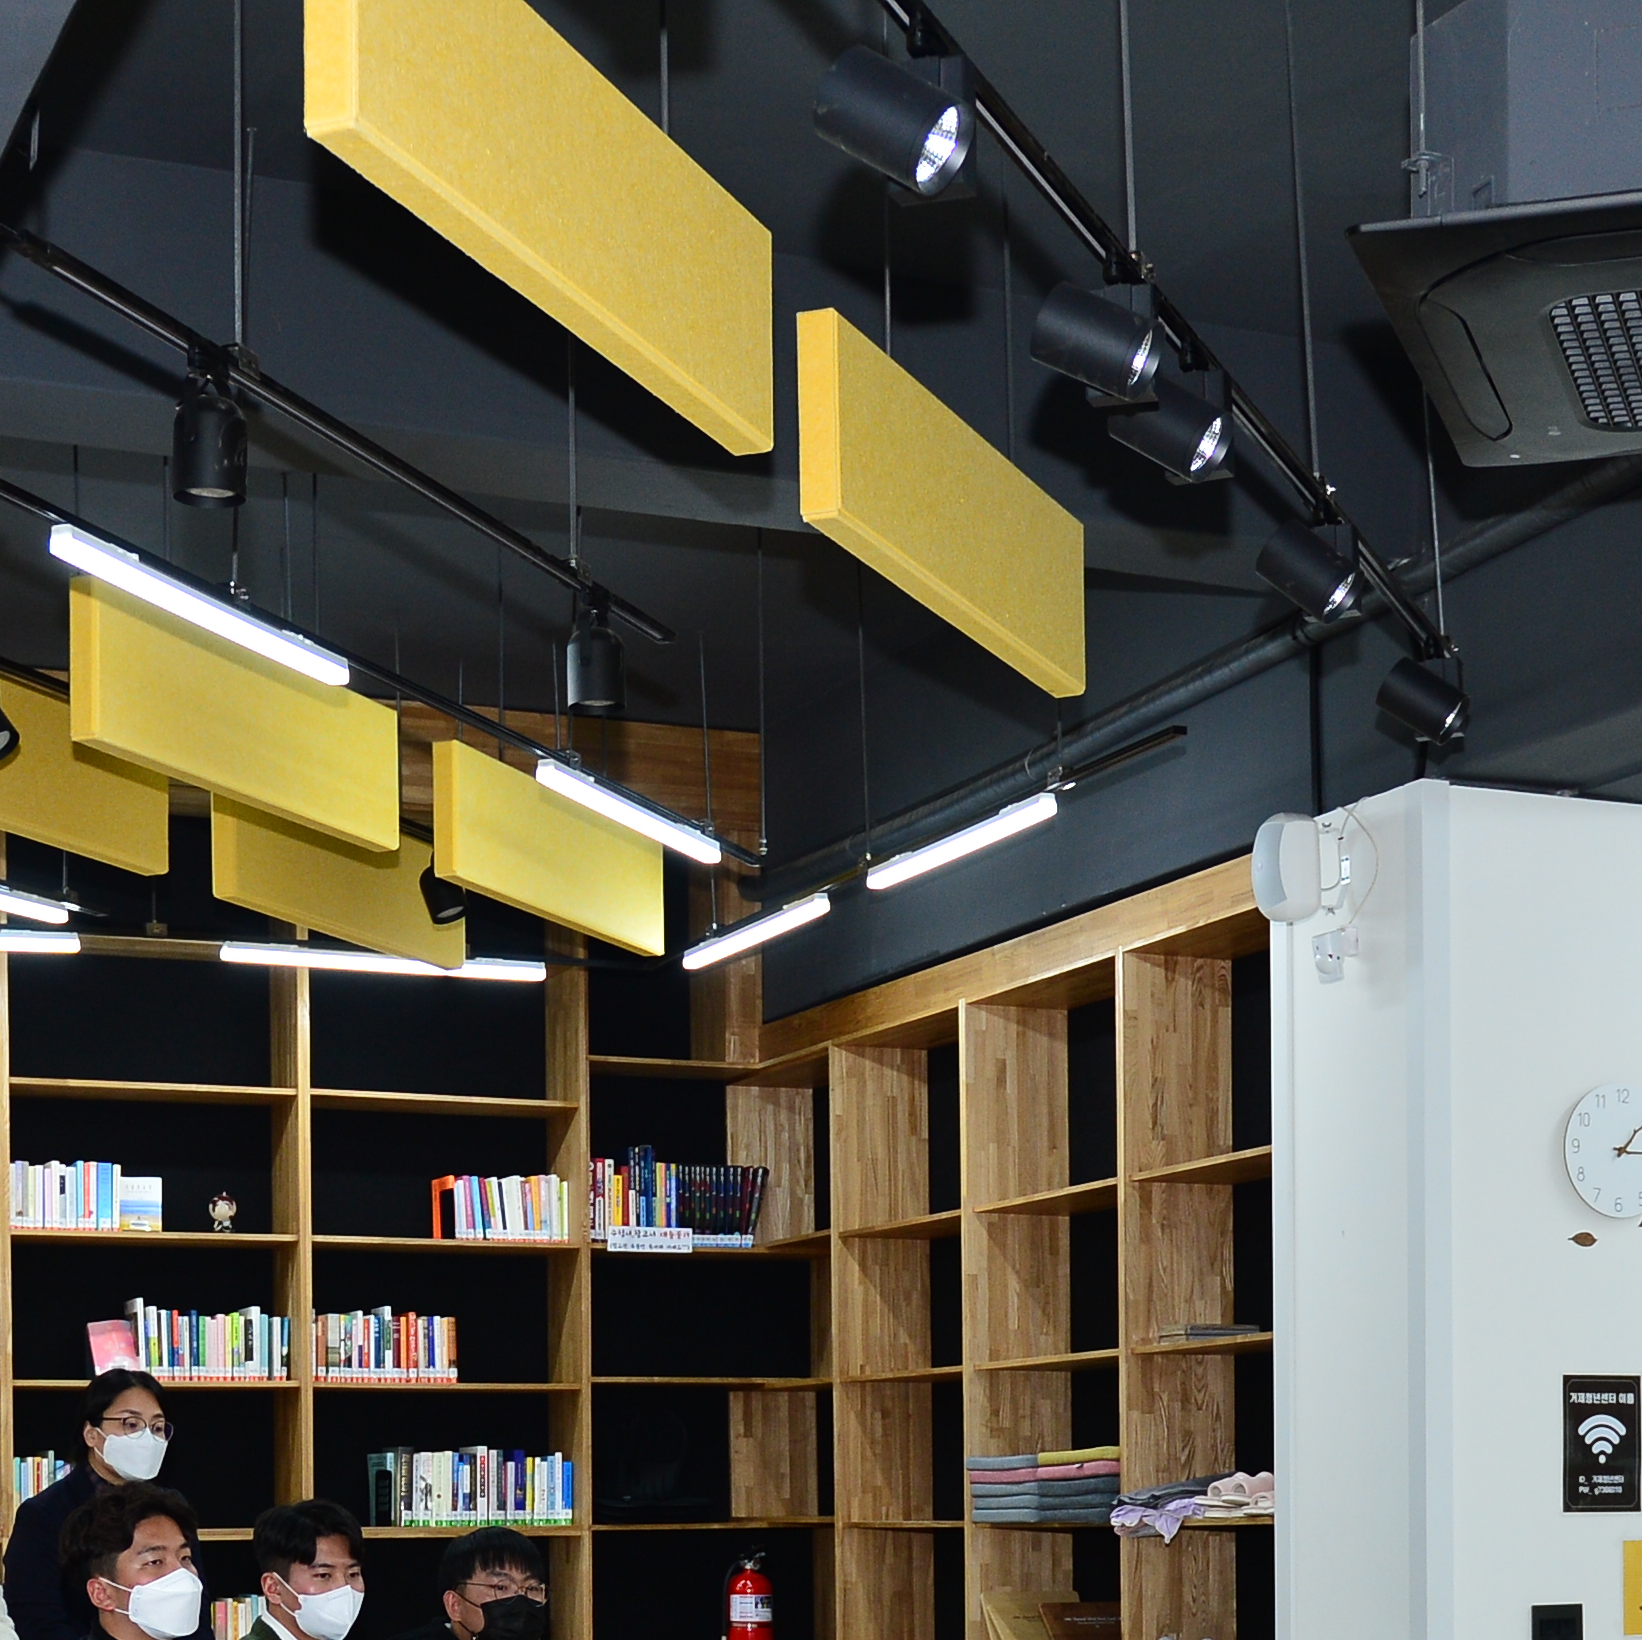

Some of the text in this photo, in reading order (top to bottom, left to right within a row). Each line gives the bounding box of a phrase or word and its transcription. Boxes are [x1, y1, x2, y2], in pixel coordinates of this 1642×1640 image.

[1595, 1094, 1606, 1109] 11
[1616, 1088, 1630, 1104] 12
[1577, 1112, 1591, 1127] 10
[1571, 1138, 1581, 1154] 9
[1576, 1166, 1586, 1182] 8
[1592, 1187, 1602, 1203] 7
[1614, 1197, 1623, 1213] 6
